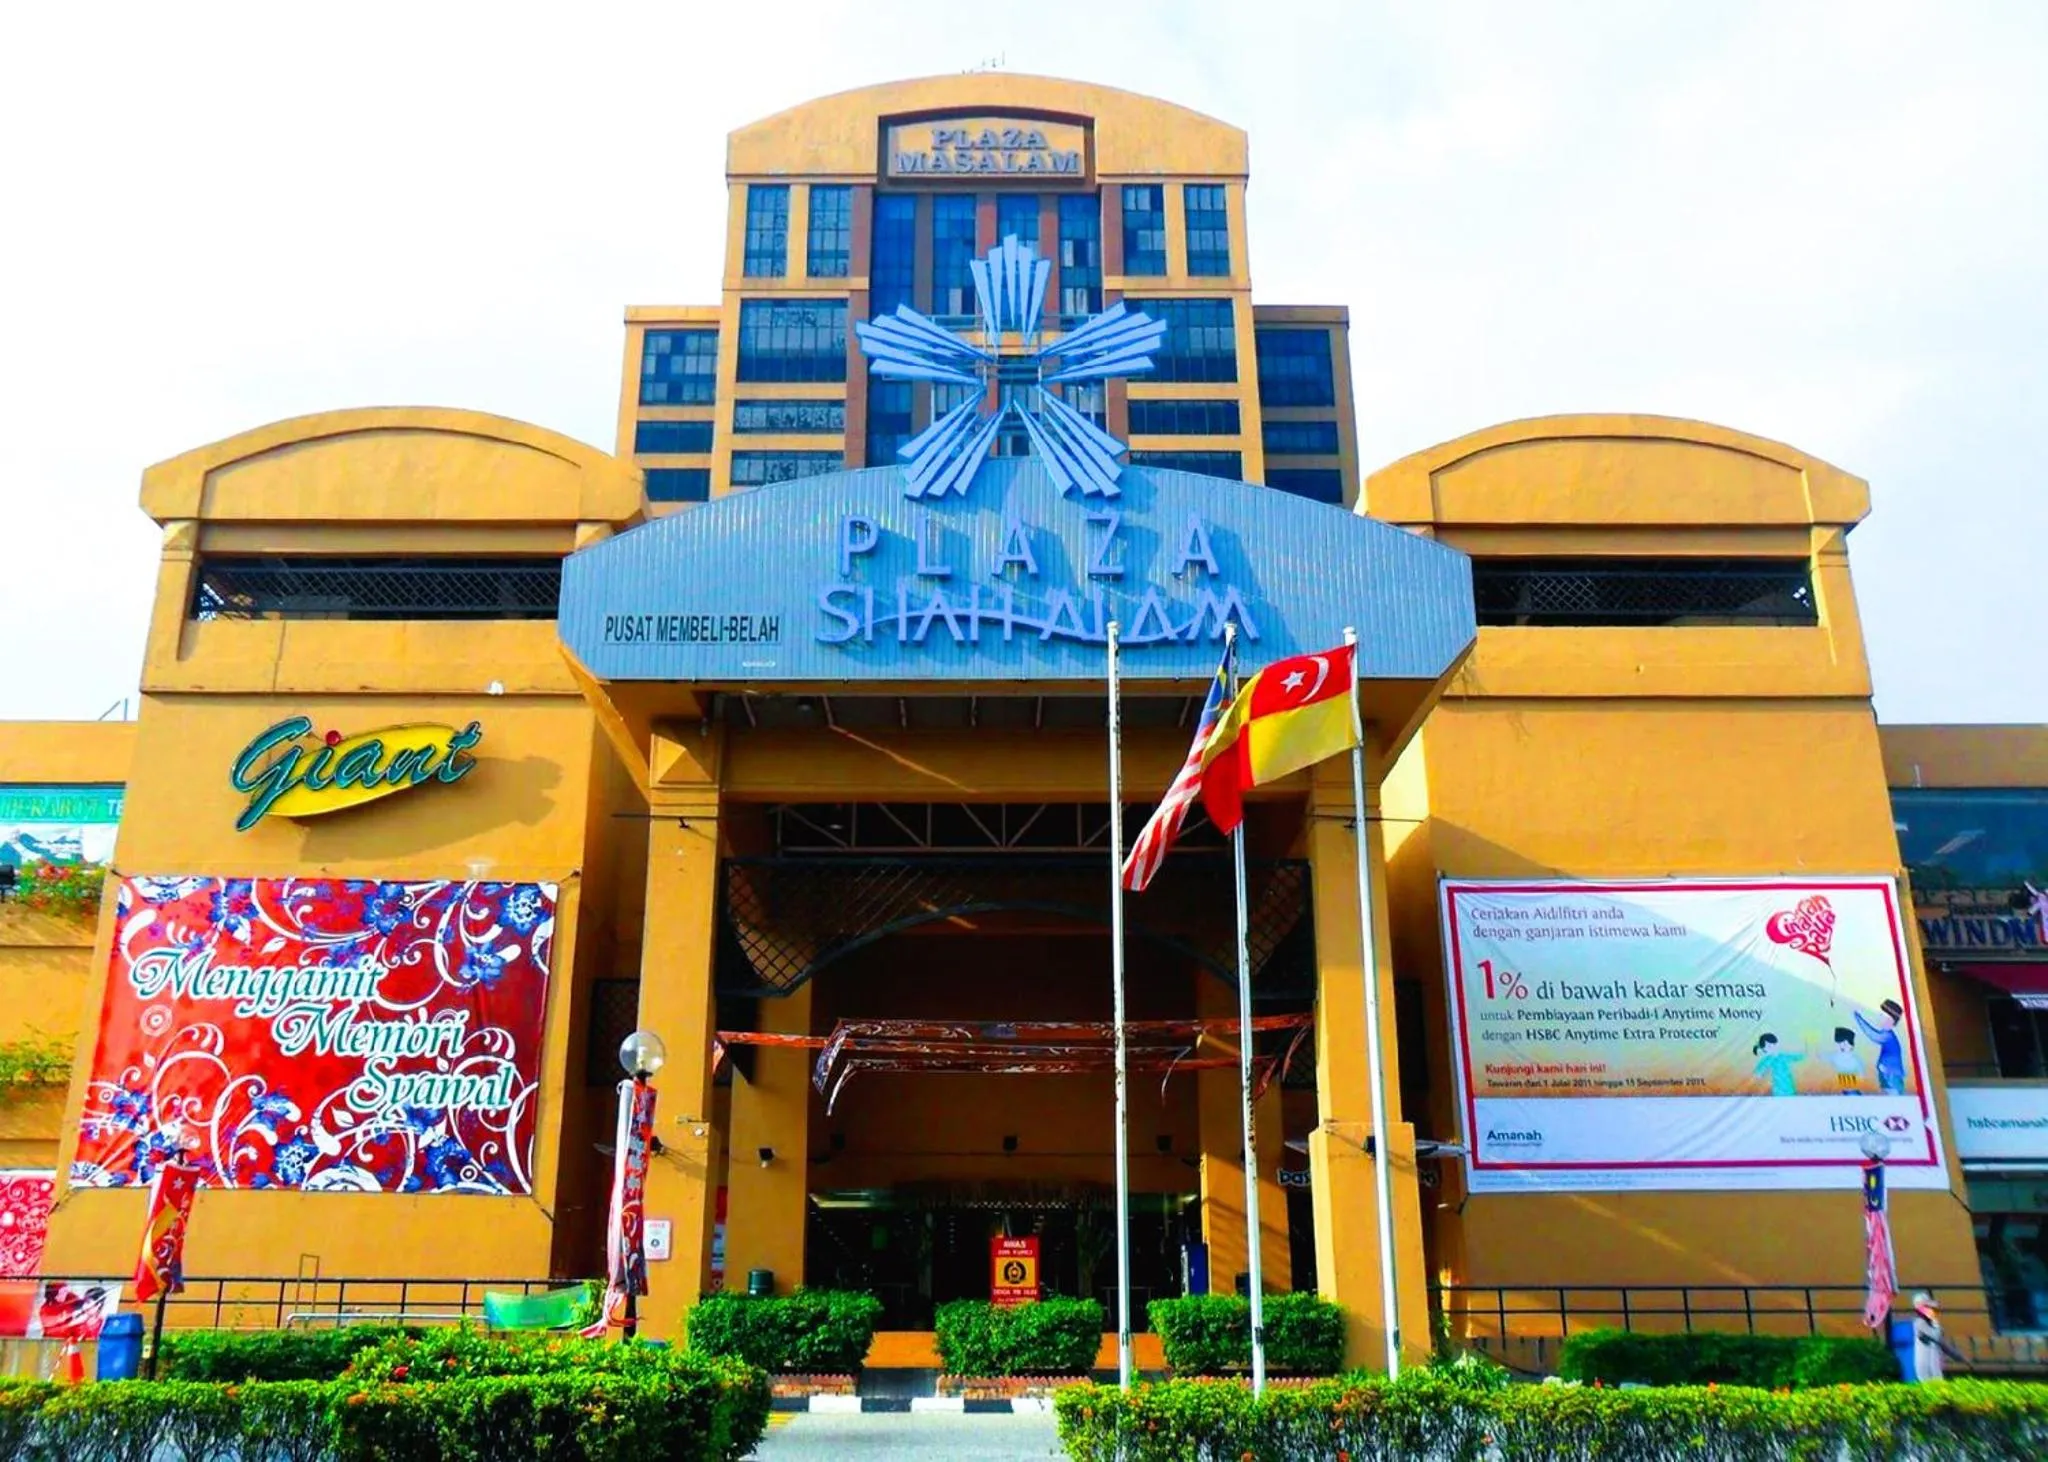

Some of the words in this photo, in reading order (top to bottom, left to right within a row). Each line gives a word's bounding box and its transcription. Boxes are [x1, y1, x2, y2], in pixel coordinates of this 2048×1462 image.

[932, 127, 1048, 150] PLAZA
[896, 151, 1080, 175] MASALAM
[839, 514, 1220, 579] PLAZA
[604, 615, 653, 643] PUSAT
[656, 614, 780, 643] MEMBELI-BELAH
[231, 716, 482, 832] Giant
[1471, 906, 1529, 921] Ceriakan
[1533, 906, 1588, 920] Aidilfitri
[1592, 907, 1625, 920] anda
[1473, 925, 1521, 939] dengan
[1526, 926, 1585, 941] ganjaran
[1588, 924, 1650, 938] istimewa
[1653, 924, 1687, 937] kami
[130, 947, 388, 1018] Menggamit
[1477, 959, 1529, 1000] 1%
[1536, 980, 1554, 1000] di
[1561, 980, 1627, 1000] bawah
[1634, 980, 1688, 1000] kadar
[1695, 983, 1766, 999] semasa
[1480, 1009, 1514, 1021] untuk
[1517, 1008, 1594, 1023] Pembiayaan
[1662, 1007, 1715, 1022] Anytime
[1718, 1008, 1763, 1021] Money
[272, 1001, 470, 1058] Memori
[1482, 1029, 1523, 1043] dengan
[1526, 1028, 1561, 1041] HSBC
[1565, 1028, 1619, 1044] Anytime
[1623, 1028, 1655, 1040] Extra
[1485, 1063, 1534, 1076] Kunjungi
[1537, 1063, 1562, 1074] kami
[346, 1056, 514, 1122] Syawal
[1573, 1078, 1592, 1088] 2011
[1637, 1077, 1684, 1088] September
[1486, 1129, 1543, 1141] Amanah
[1829, 1115, 1879, 1132] HSBC
